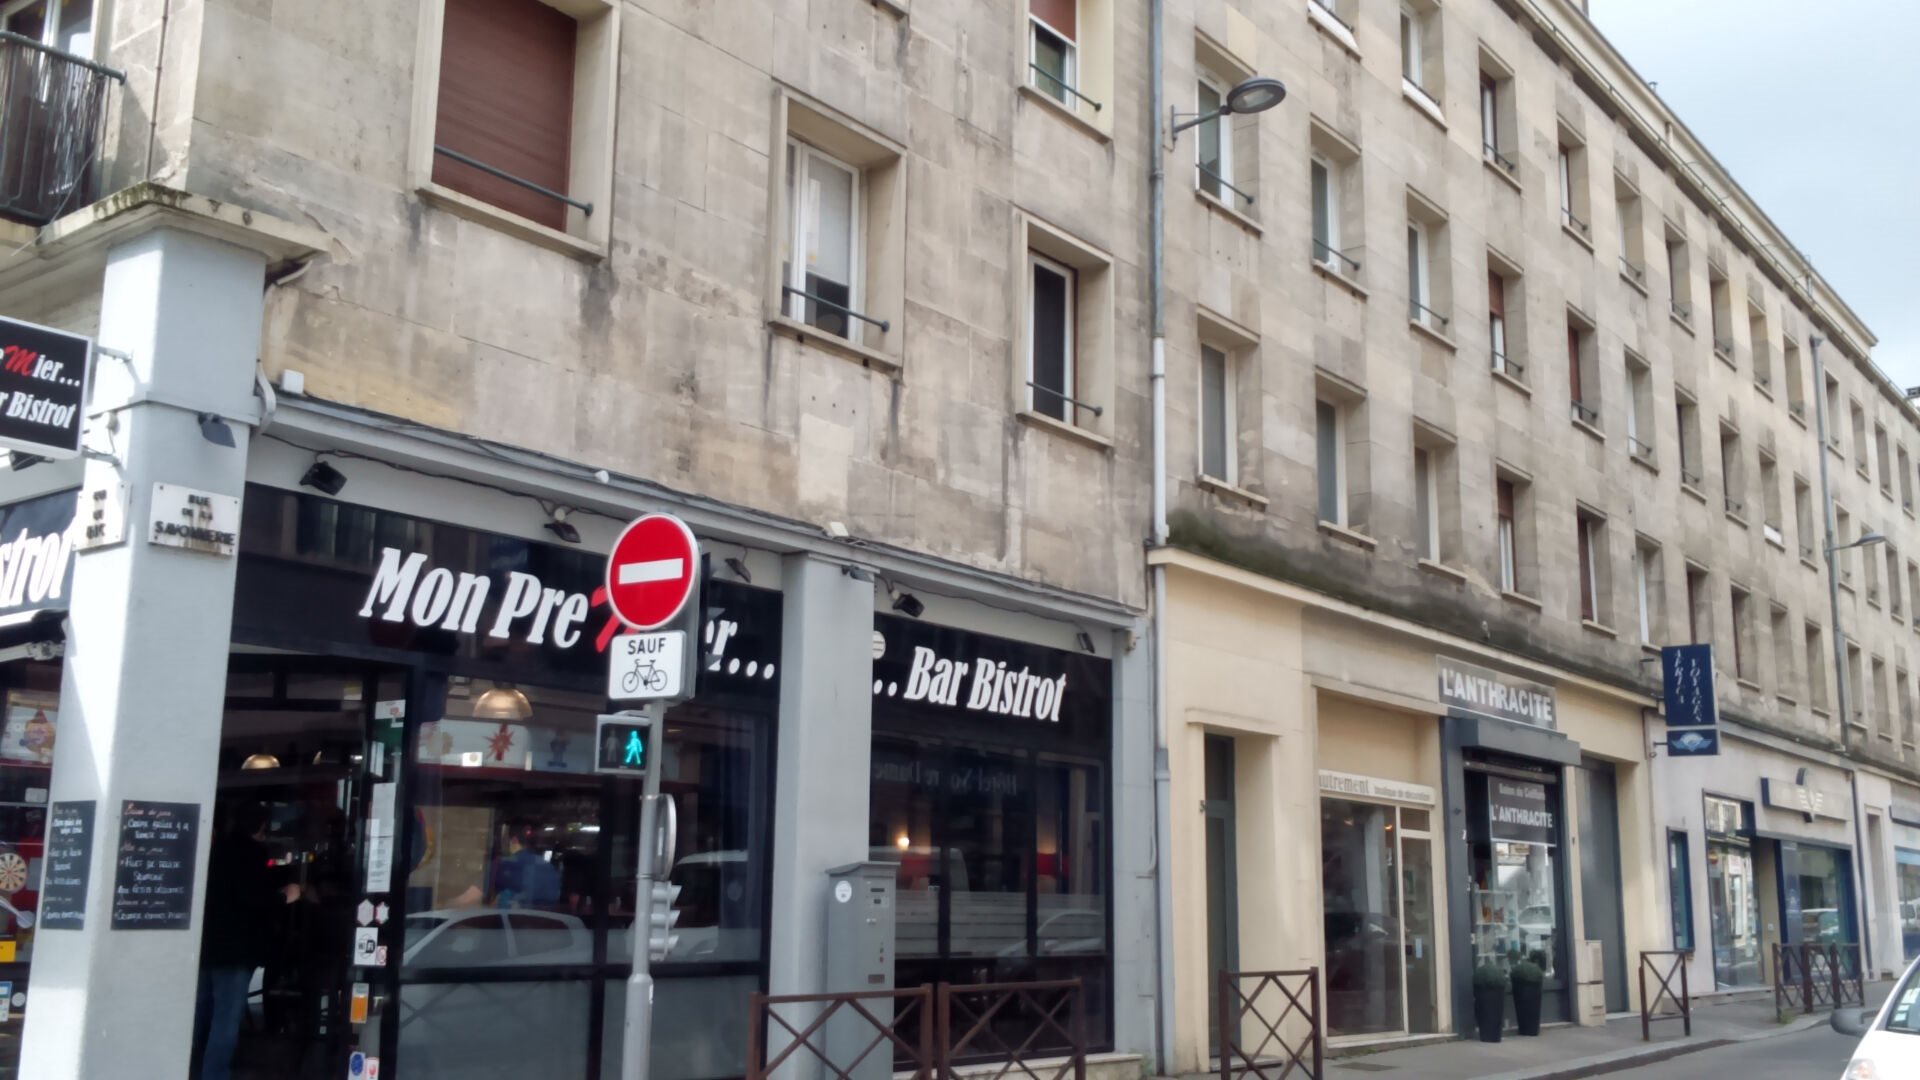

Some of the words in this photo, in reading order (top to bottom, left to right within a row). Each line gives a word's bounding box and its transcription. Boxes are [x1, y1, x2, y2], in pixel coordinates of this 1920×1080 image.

[6, 391, 77, 429] Bistrot
[188, 494, 211, 506] RUE
[154, 520, 236, 546] SAVONNERIE
[359, 547, 490, 633] Mon
[627, 637, 667, 656] SAUF
[904, 645, 969, 706] Bar
[966, 657, 1067, 722] Bistrot
[1442, 668, 1553, 721] L'ANTHRACITE
